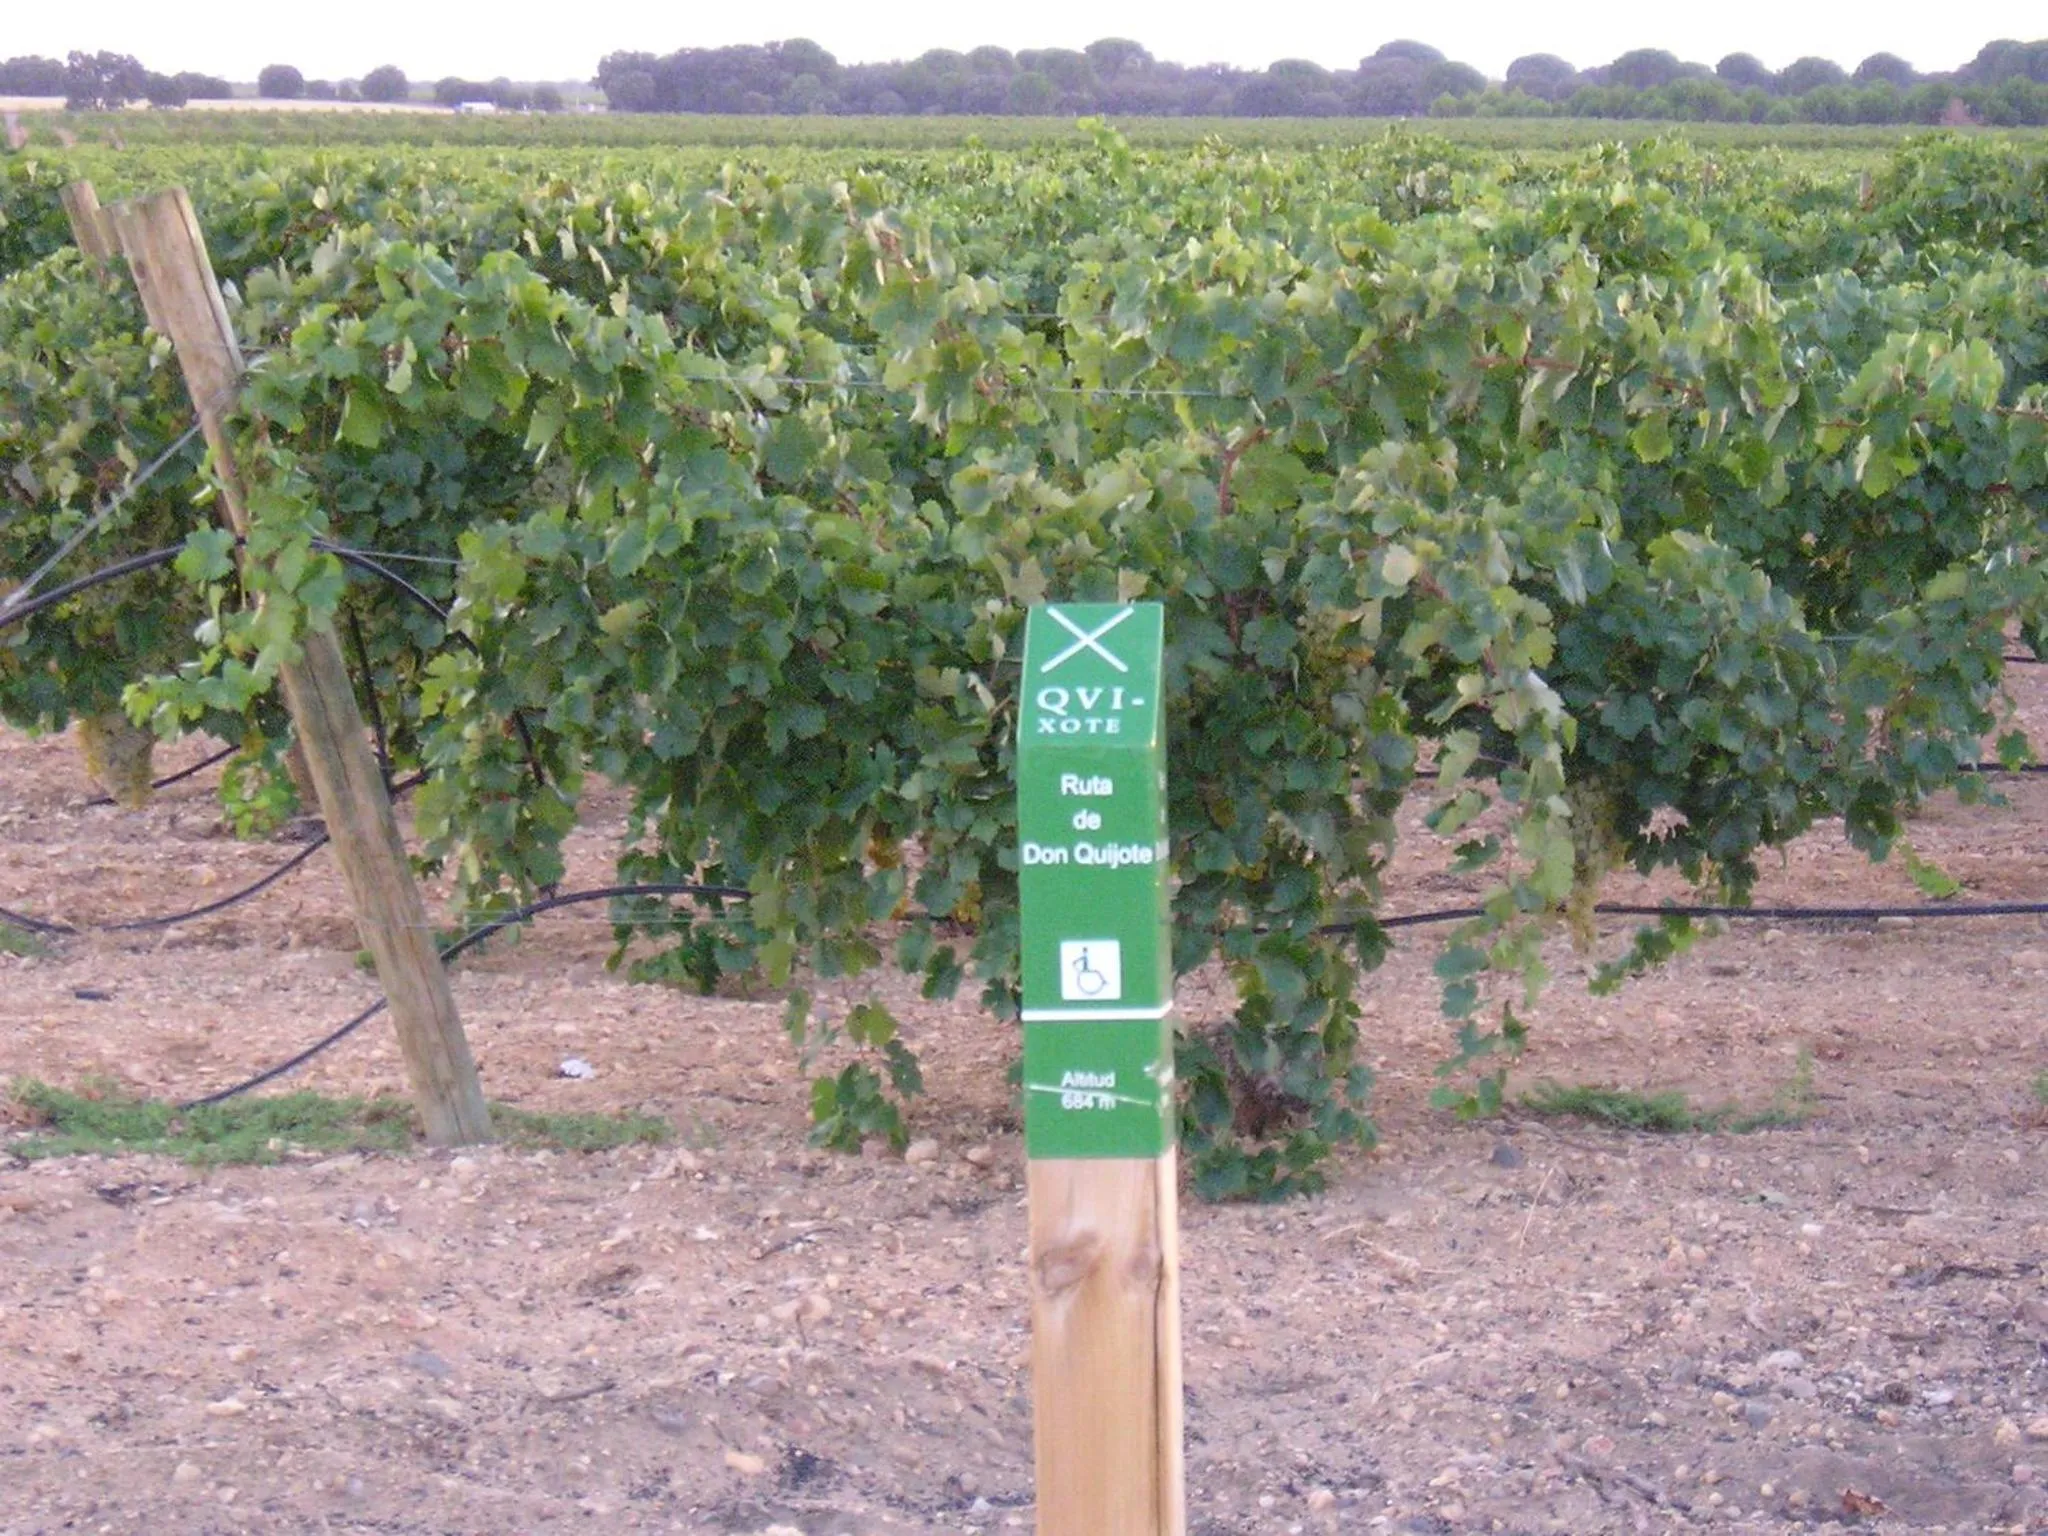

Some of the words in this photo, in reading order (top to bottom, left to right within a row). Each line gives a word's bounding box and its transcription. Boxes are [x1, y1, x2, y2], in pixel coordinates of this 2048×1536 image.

[1038, 718, 1120, 733] XOTE
[1061, 774, 1113, 796] Ruta
[1073, 809, 1101, 830] de
[1023, 843, 1068, 864] Don
[1074, 842, 1153, 868] Quijote
[1061, 1070, 1116, 1088] Altitud
[1098, 1096, 1116, 1110] m
